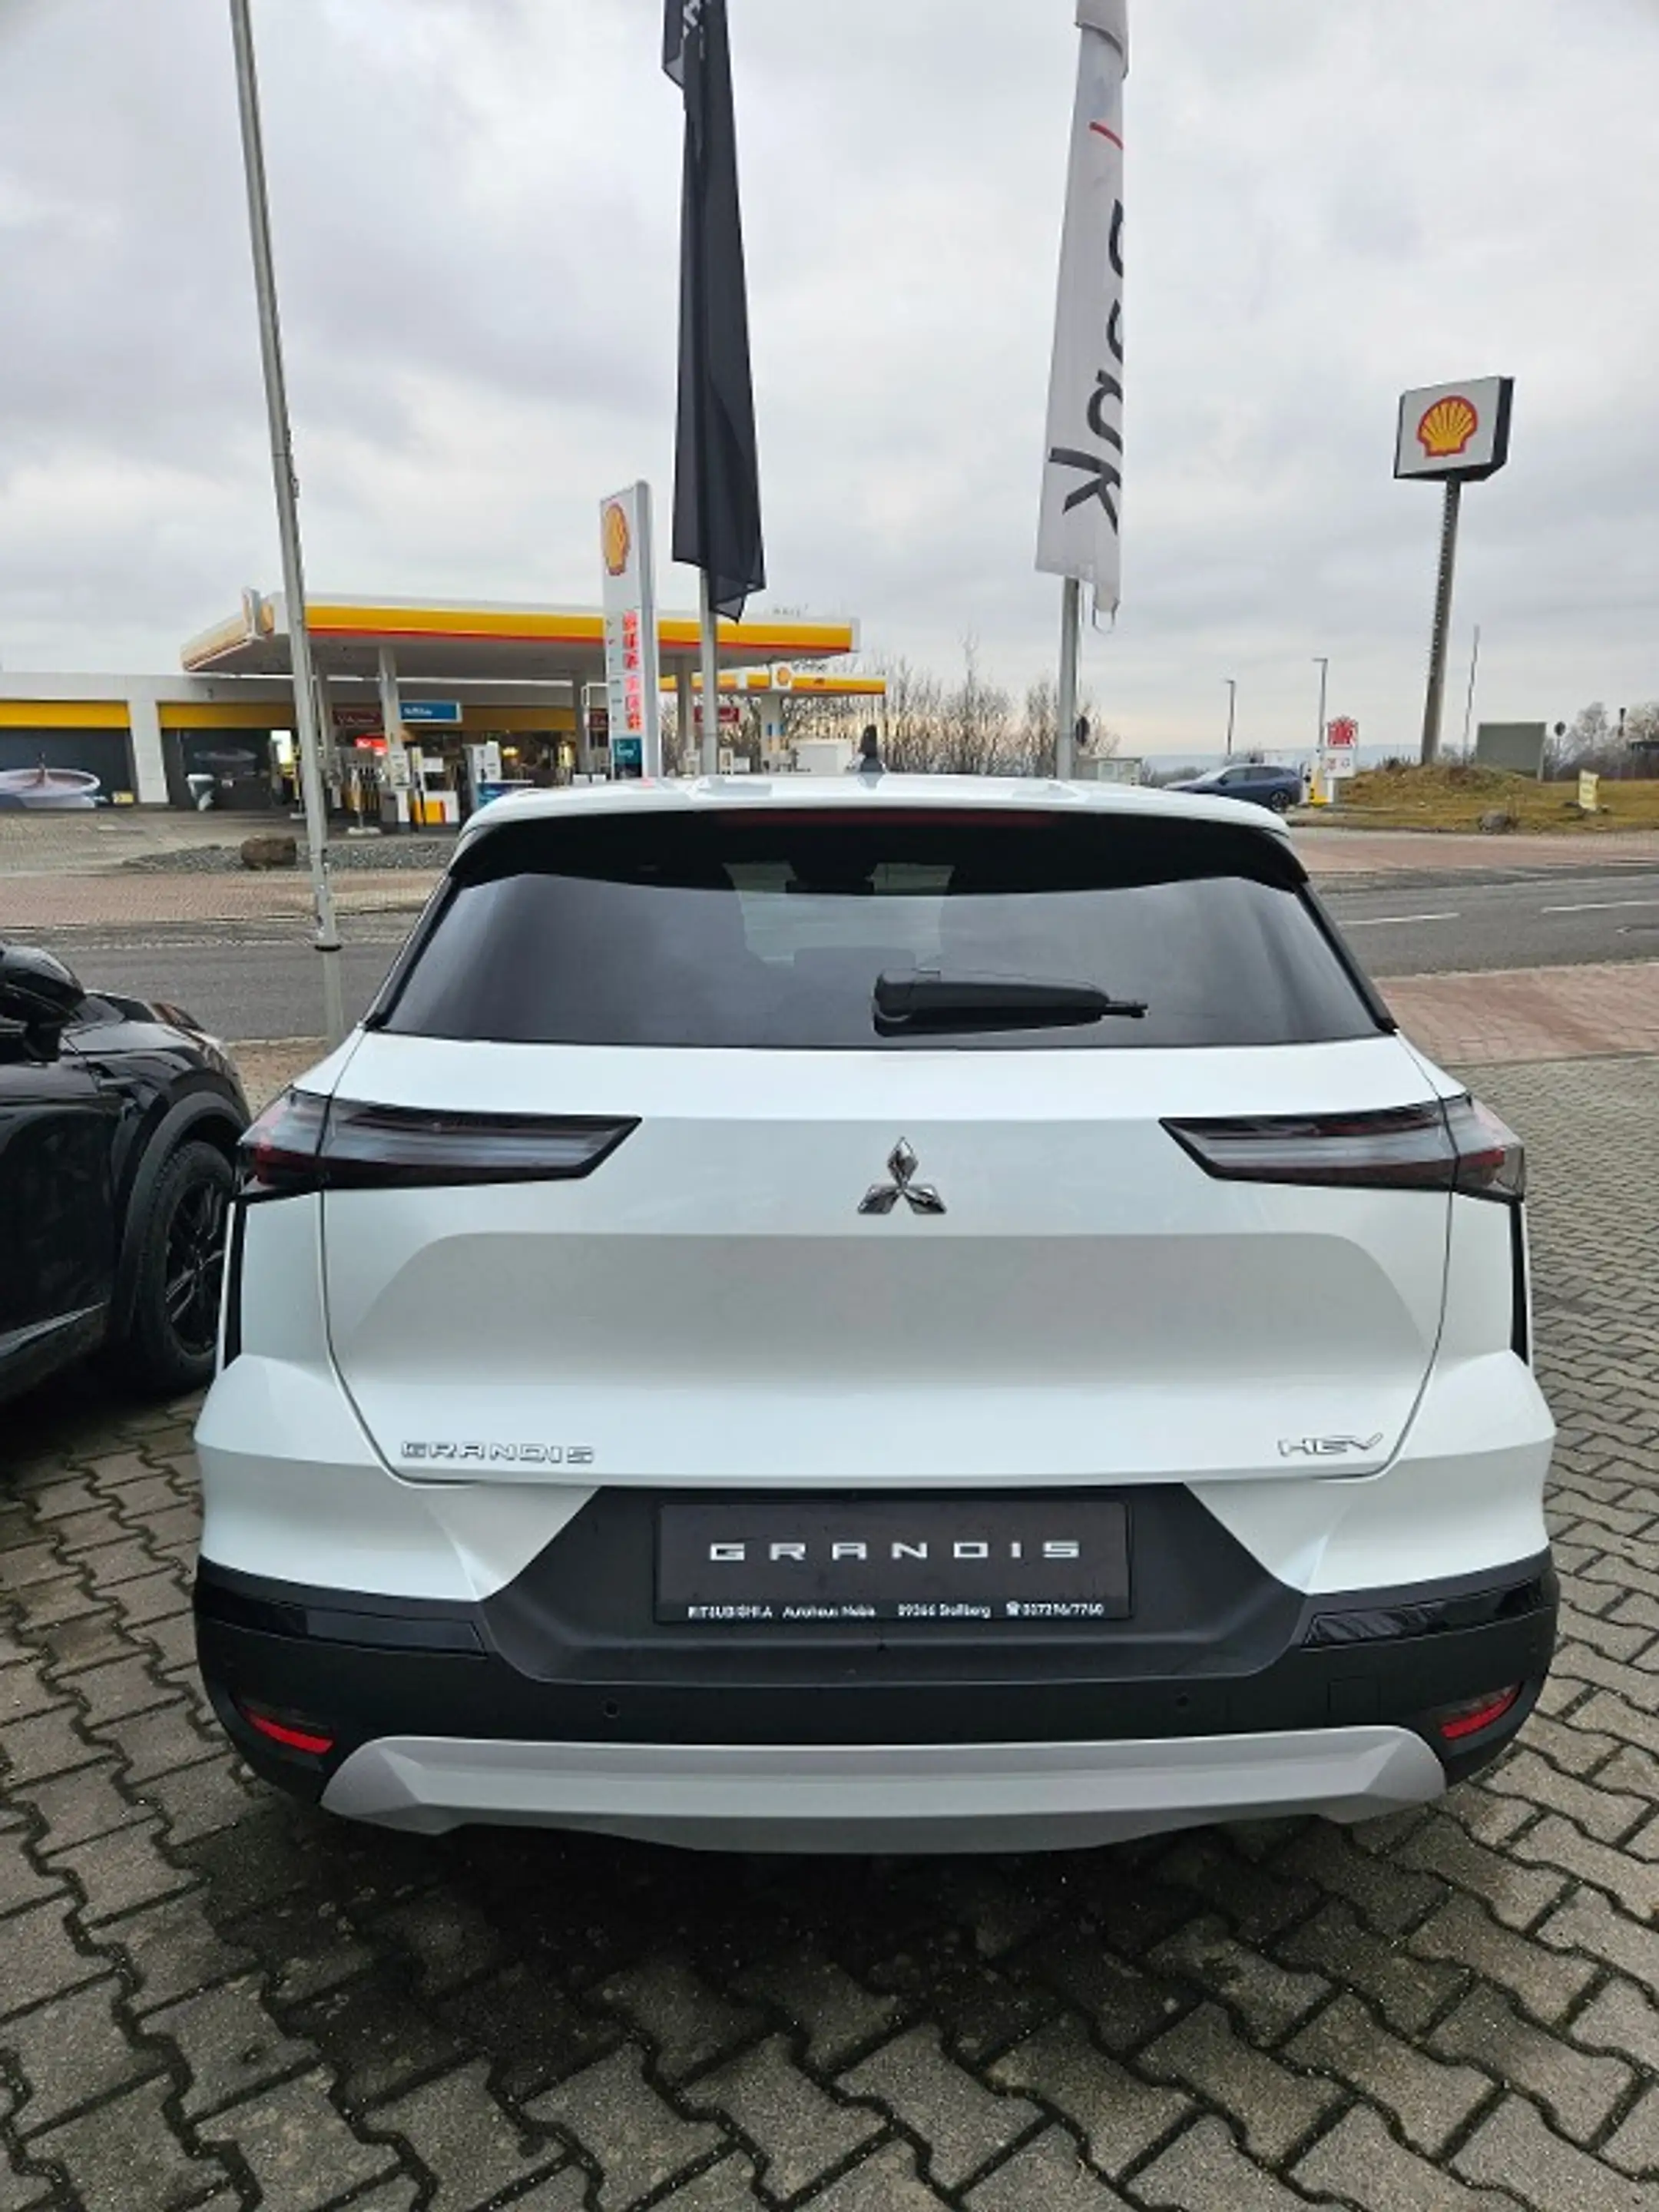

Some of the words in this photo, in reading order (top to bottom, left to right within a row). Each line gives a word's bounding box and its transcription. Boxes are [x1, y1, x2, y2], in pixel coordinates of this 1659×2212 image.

[401, 1441, 595, 1465] GRANDIS
[1277, 1432, 1383, 1457] HEV
[709, 1540, 1080, 1561] GRANDIS
